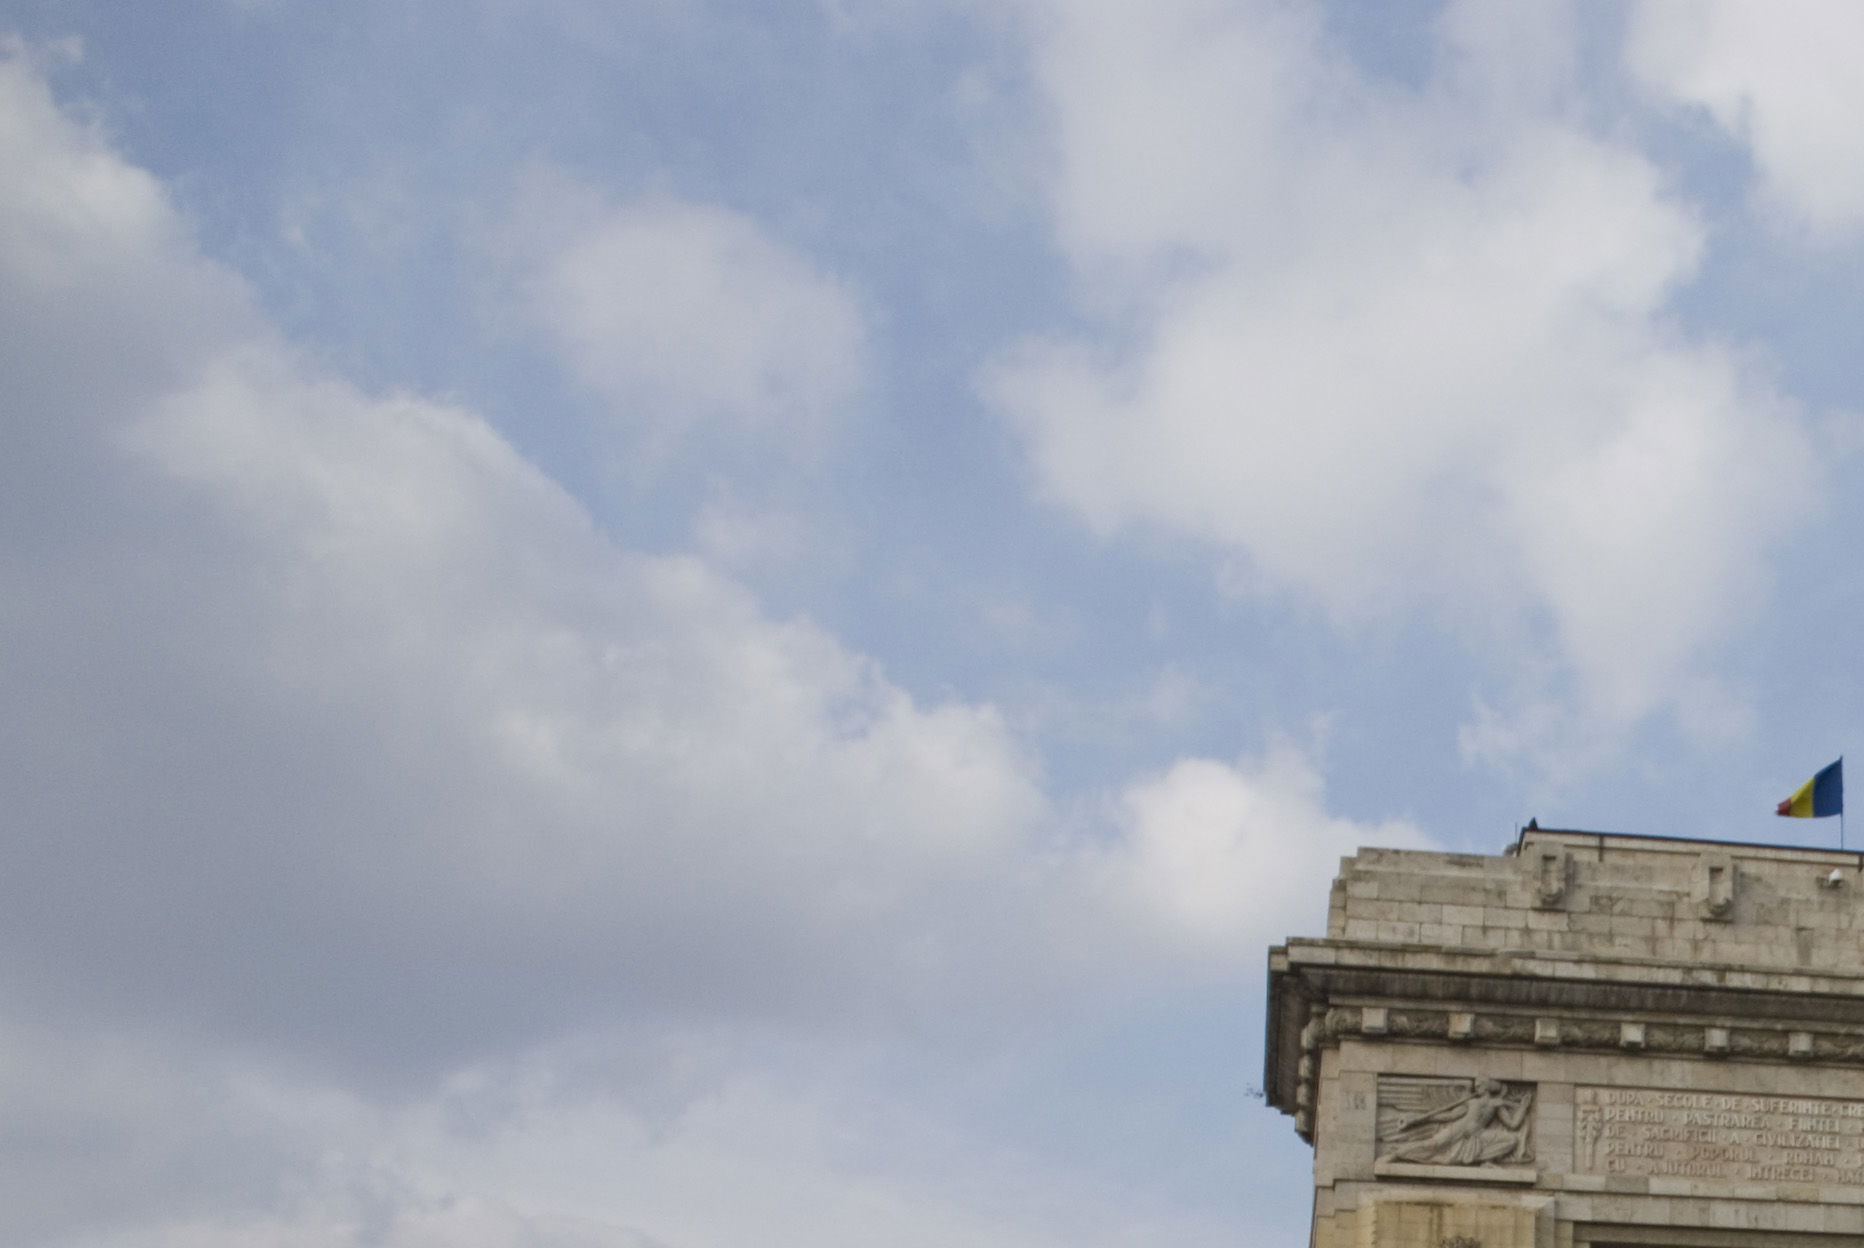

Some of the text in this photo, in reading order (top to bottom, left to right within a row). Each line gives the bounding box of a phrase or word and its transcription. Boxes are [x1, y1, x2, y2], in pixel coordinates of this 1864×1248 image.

[1656, 1093, 1711, 1109] SECOLE
[1721, 1096, 1740, 1111] DE
[1604, 1108, 1664, 1124] PENTRU
[1604, 1126, 1627, 1140] DE
[1729, 1132, 1741, 1145] A
[1604, 1143, 1665, 1158] PENTRU
[1784, 1151, 1835, 1167] ROMAN
[1606, 1159, 1627, 1174] CU
